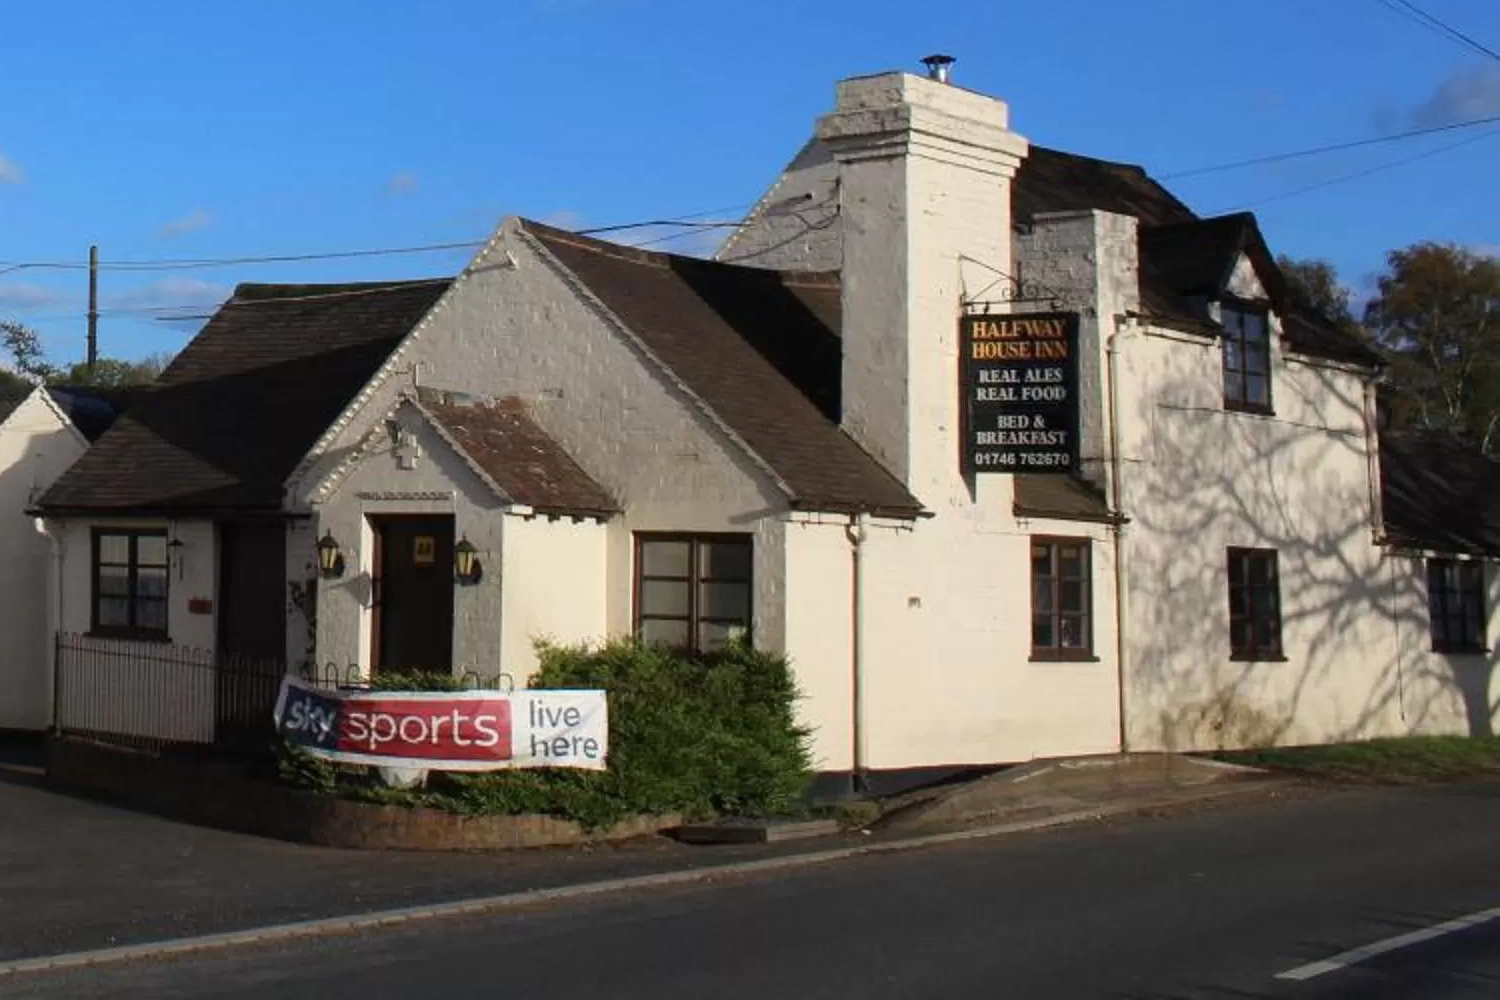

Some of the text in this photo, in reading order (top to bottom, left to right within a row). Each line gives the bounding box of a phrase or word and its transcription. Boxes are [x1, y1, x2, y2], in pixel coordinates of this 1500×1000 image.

[972, 320, 1065, 338] HALFWAY
[972, 341, 1068, 359] HOUSE INN
[979, 367, 1063, 383] REAL ALES
[976, 386, 1067, 401] REAL FOOD
[997, 415, 1046, 429] BED &
[976, 431, 1066, 445] BREAKFAST
[285, 697, 500, 750] sky sports
[529, 699, 581, 730] live
[529, 734, 599, 760] here
